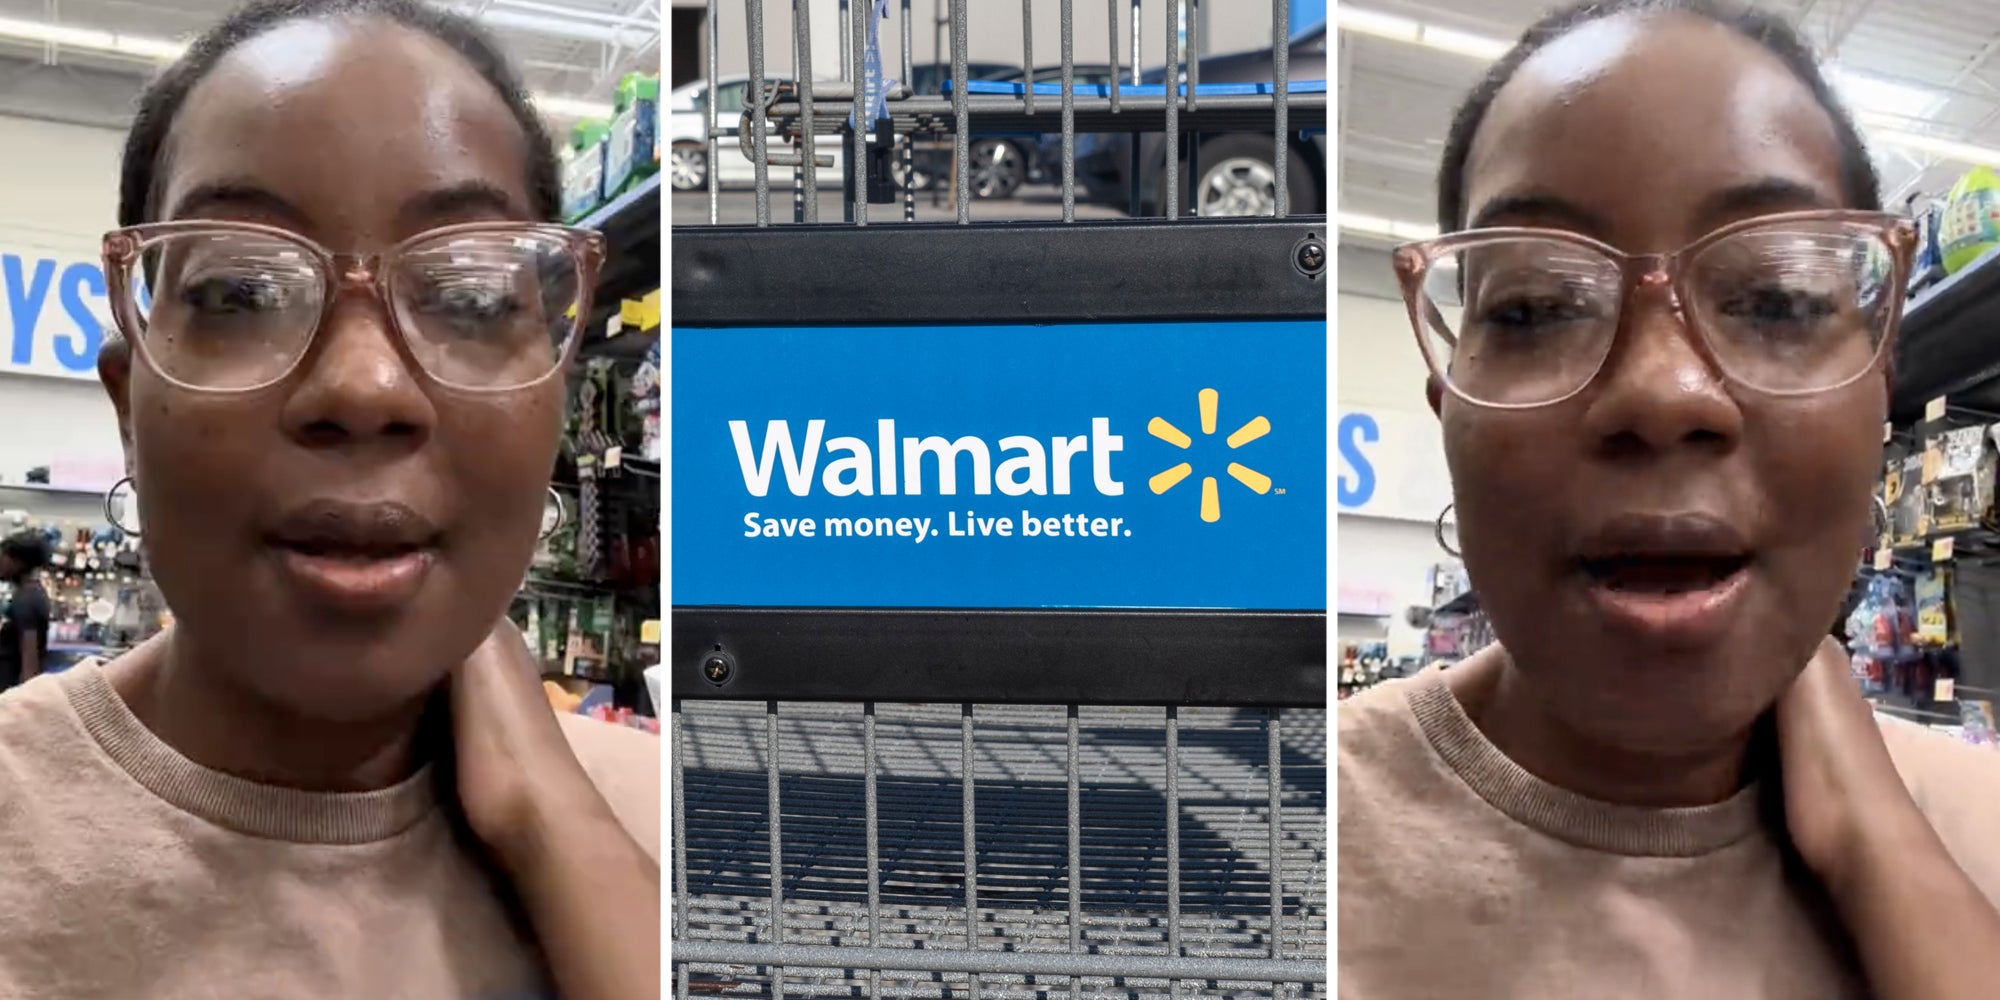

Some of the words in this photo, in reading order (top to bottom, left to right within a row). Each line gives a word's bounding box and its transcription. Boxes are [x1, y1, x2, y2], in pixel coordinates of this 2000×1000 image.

[2, 255, 106, 372] YS
[728, 417, 1125, 498] Walmart
[1338, 414, 1379, 508] S
[743, 511, 817, 538] Save
[824, 517, 939, 544] money.
[948, 510, 1014, 537] Live
[1021, 509, 1132, 537] better.
